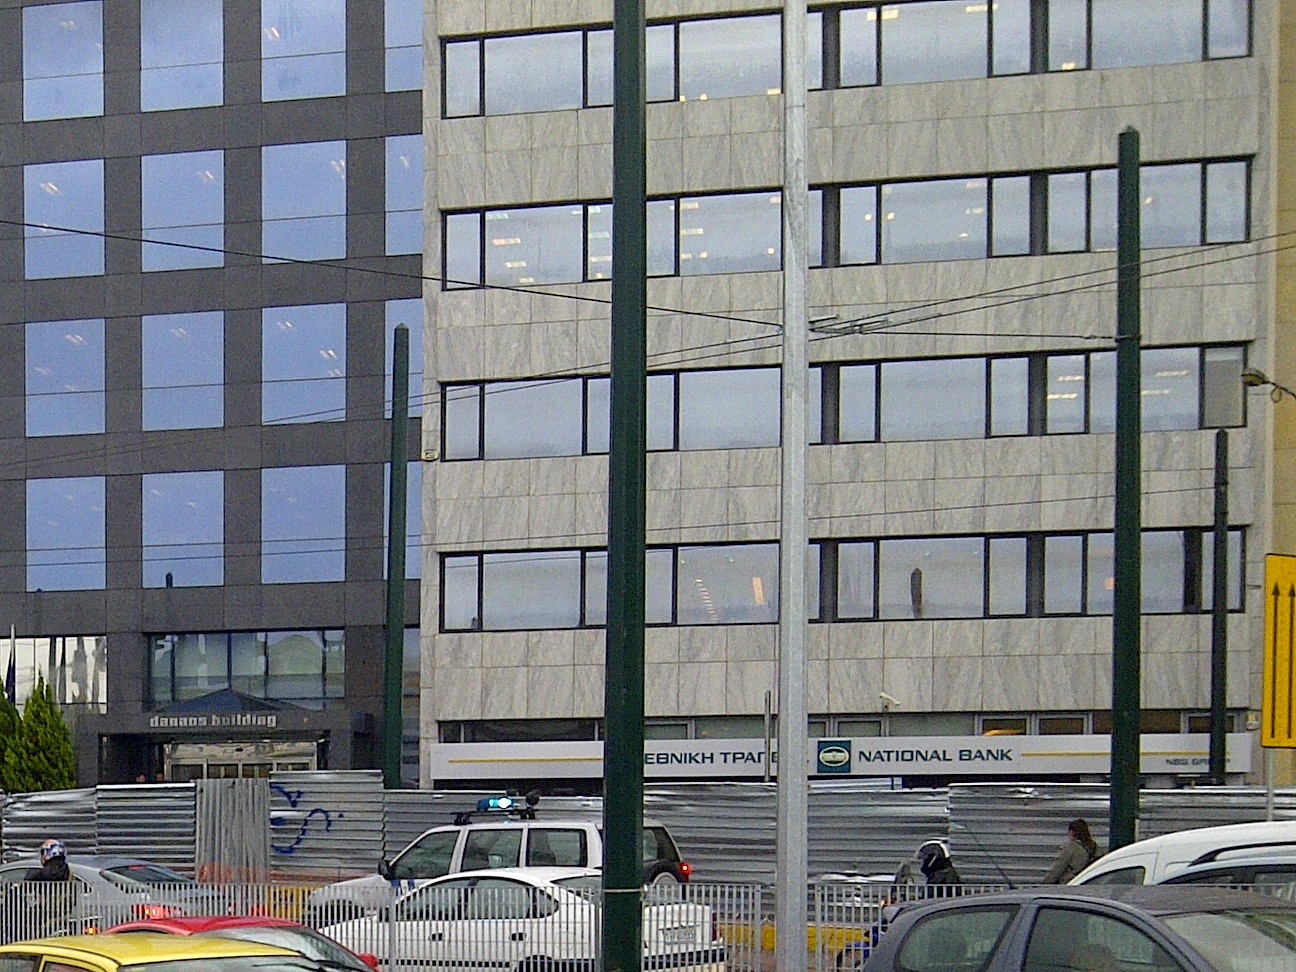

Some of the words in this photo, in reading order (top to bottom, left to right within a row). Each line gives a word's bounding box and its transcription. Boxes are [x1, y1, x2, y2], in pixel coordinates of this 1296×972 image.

[211, 713, 277, 728] building
[858, 750, 953, 762] NATIONAL
[958, 748, 1013, 762] BANK
